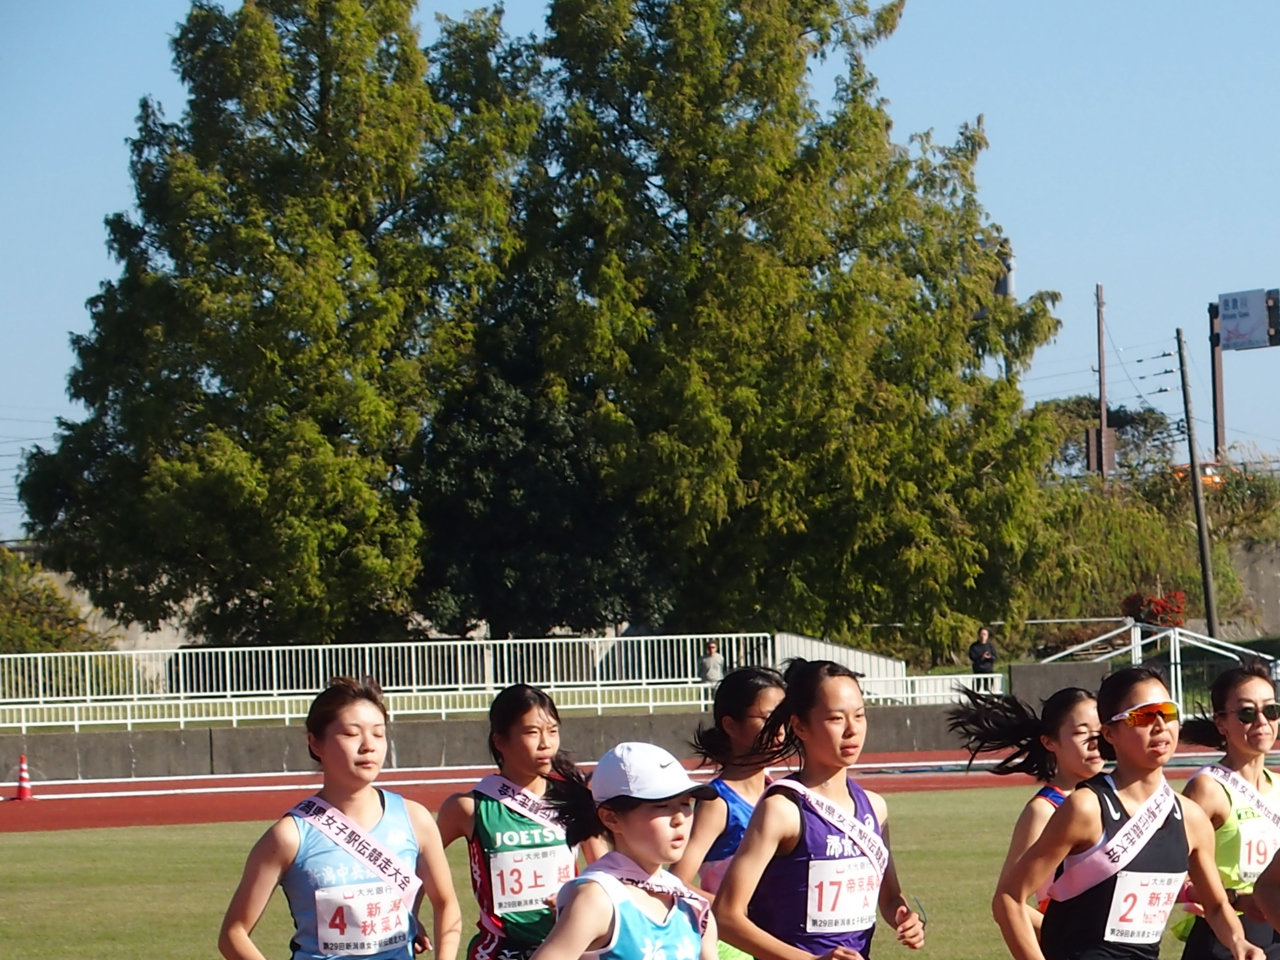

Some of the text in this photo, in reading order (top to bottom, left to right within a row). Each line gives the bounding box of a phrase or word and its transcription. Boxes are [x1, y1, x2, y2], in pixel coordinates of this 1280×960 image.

[1245, 840, 1267, 865] 19
[496, 868, 523, 896] 13
[814, 881, 842, 912] 17
[328, 906, 347, 936] 4
[1118, 893, 1138, 923] 2
